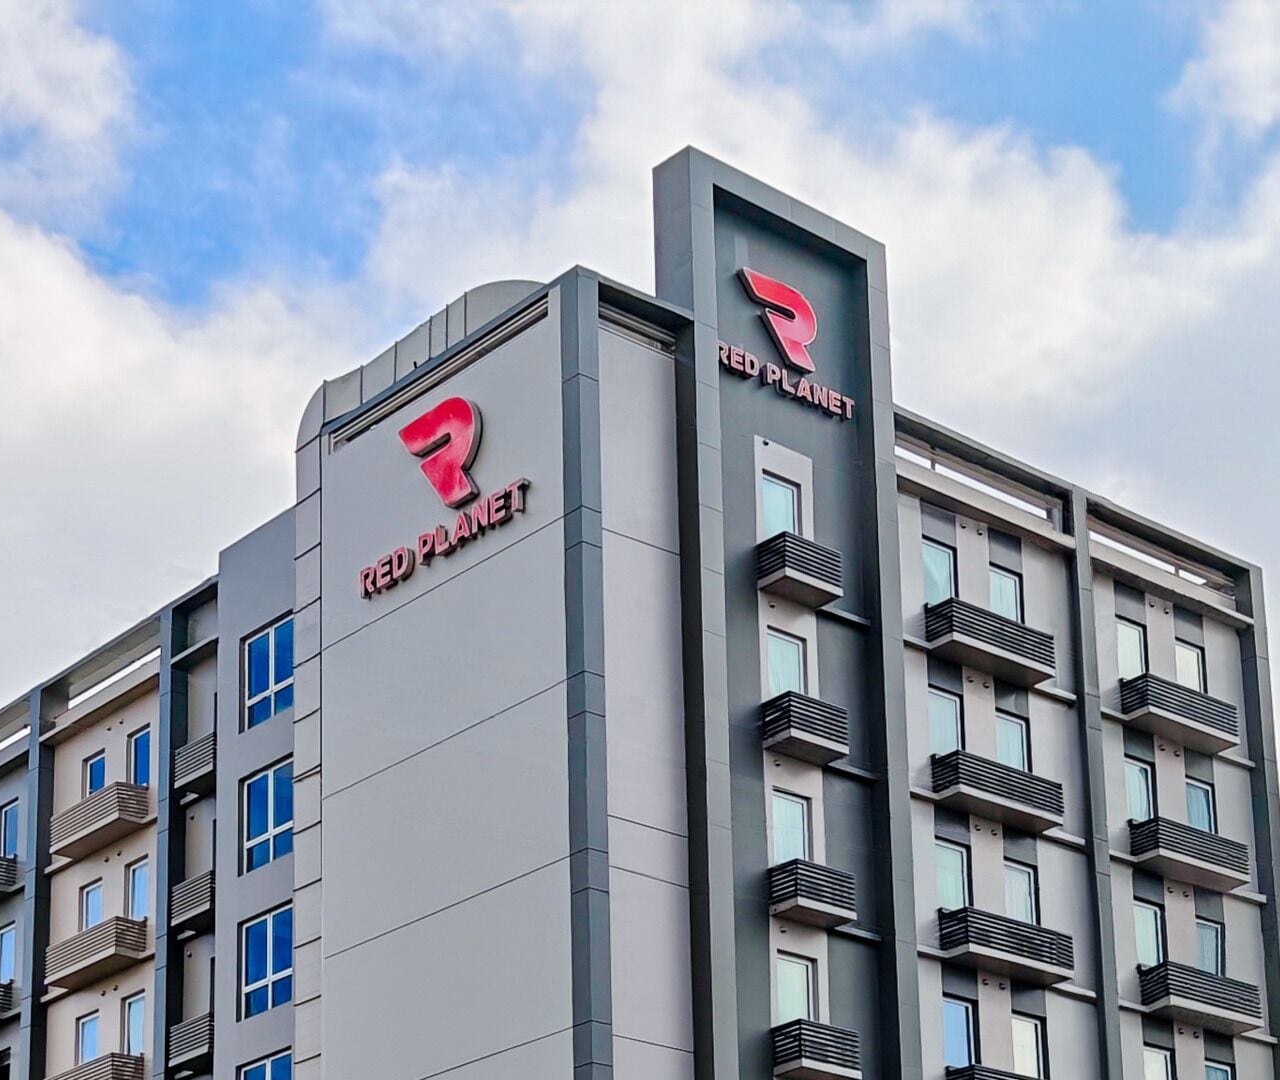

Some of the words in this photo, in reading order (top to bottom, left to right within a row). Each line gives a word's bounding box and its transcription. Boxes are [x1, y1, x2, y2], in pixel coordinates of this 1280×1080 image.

[717, 339, 760, 378] RED
[762, 361, 856, 421] PLANET
[359, 546, 415, 600] RED
[417, 478, 531, 566] PLANET
